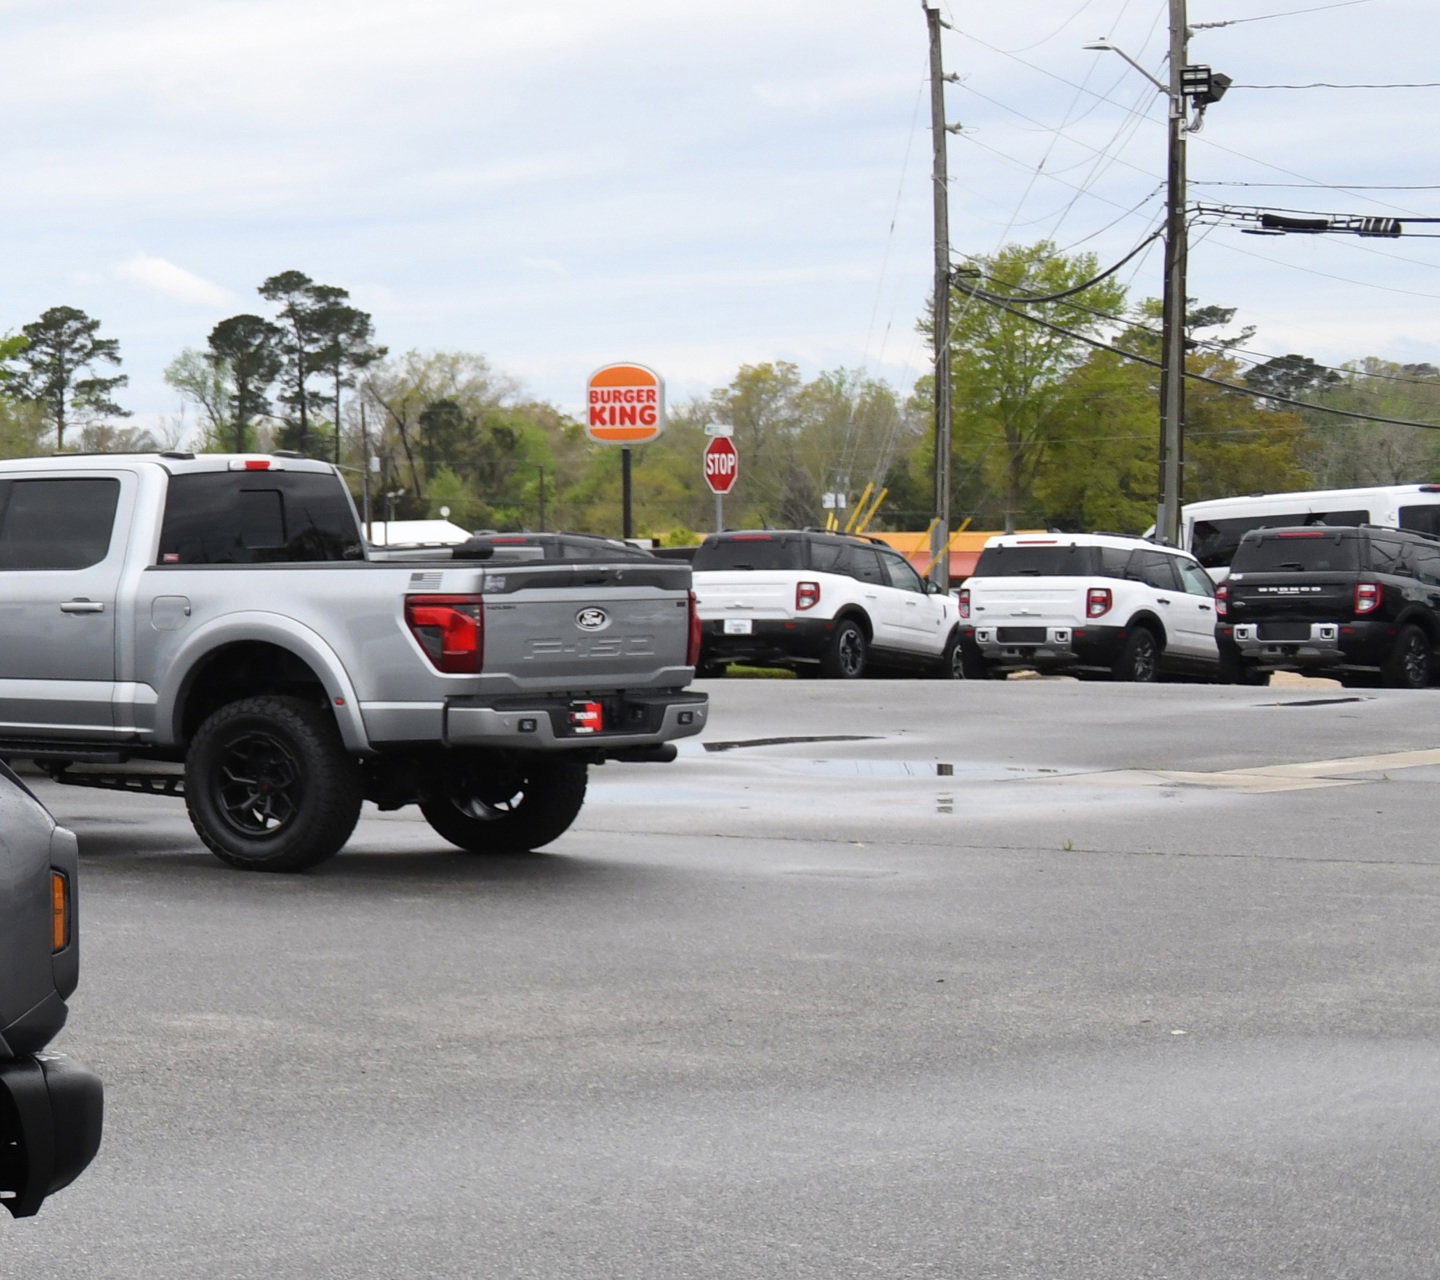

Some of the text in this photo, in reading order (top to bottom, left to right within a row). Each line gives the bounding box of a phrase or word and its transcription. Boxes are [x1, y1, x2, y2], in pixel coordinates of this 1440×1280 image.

[589, 389, 656, 404] BURGER
[589, 405, 657, 426] KING
[706, 453, 736, 475] STOP
